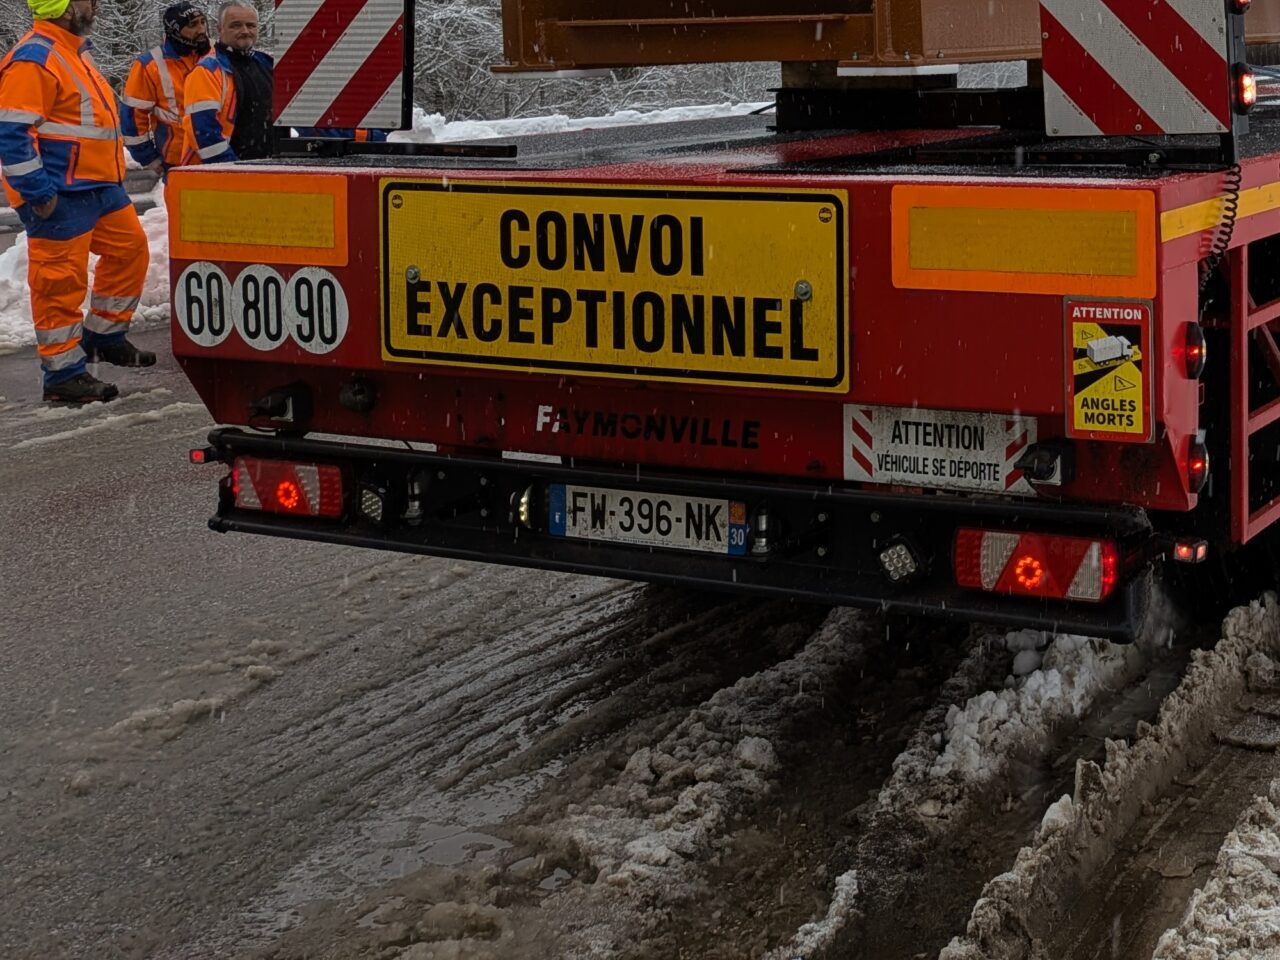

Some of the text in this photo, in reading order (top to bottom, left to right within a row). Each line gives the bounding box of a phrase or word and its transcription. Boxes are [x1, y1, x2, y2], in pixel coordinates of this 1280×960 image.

[500, 208, 705, 277] CONVOI
[185, 270, 226, 337] 60
[242, 273, 283, 342] 80
[294, 276, 338, 345] 90
[406, 279, 820, 362] EXCEPTIONNEL
[1072, 306, 1142, 320] ATTENTION
[536, 404, 761, 449] FAYMONVILLE
[1081, 397, 1137, 412] ANGLES
[1084, 412, 1134, 427] MORTS
[891, 419, 985, 451] ATTENTION
[877, 449, 1000, 482] VÉHICULE SE DÉPORTE
[571, 491, 723, 542] FW-396-NK
[730, 527, 745, 546] 30
